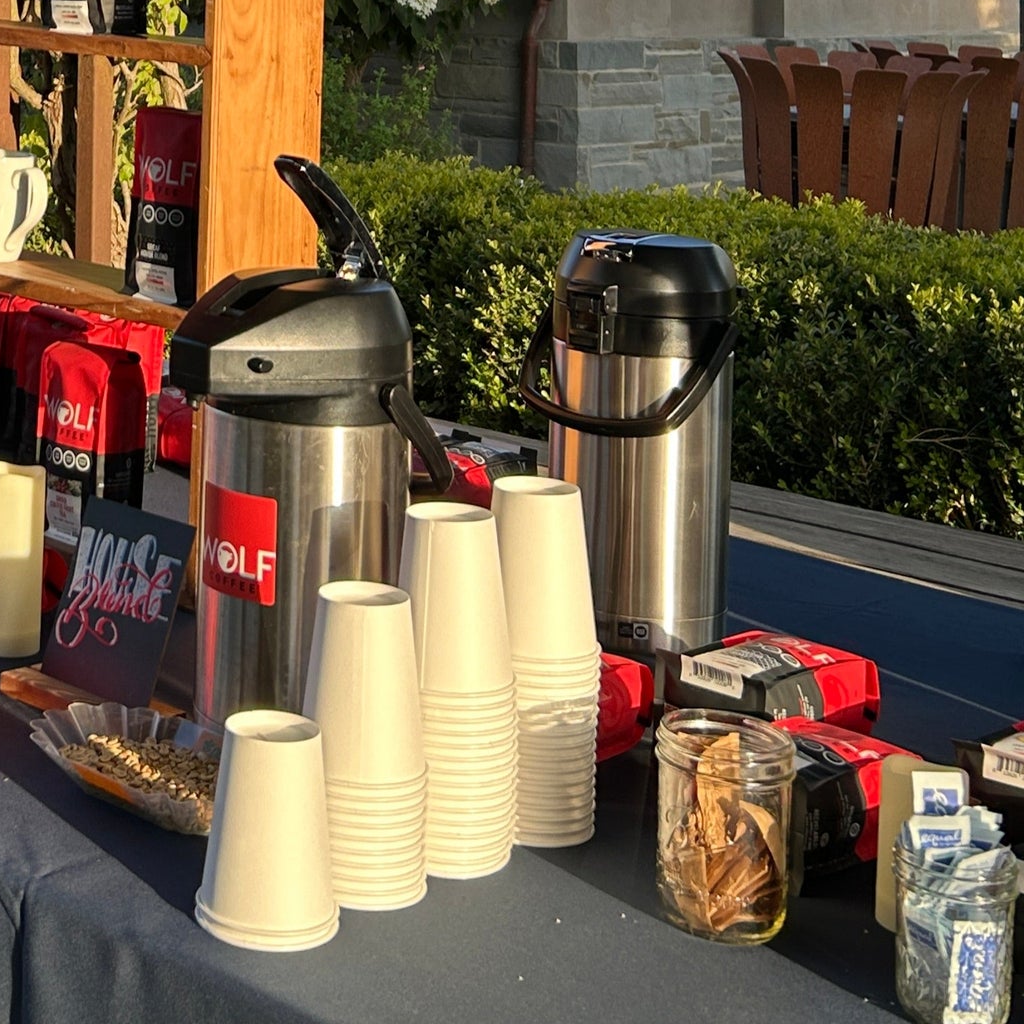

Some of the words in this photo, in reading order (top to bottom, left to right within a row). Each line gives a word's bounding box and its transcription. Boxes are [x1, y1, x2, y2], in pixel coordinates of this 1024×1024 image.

[69, 526, 182, 622] HOUSE
[209, 569, 256, 595] COFFEE
[769, 636, 837, 666] OLF
